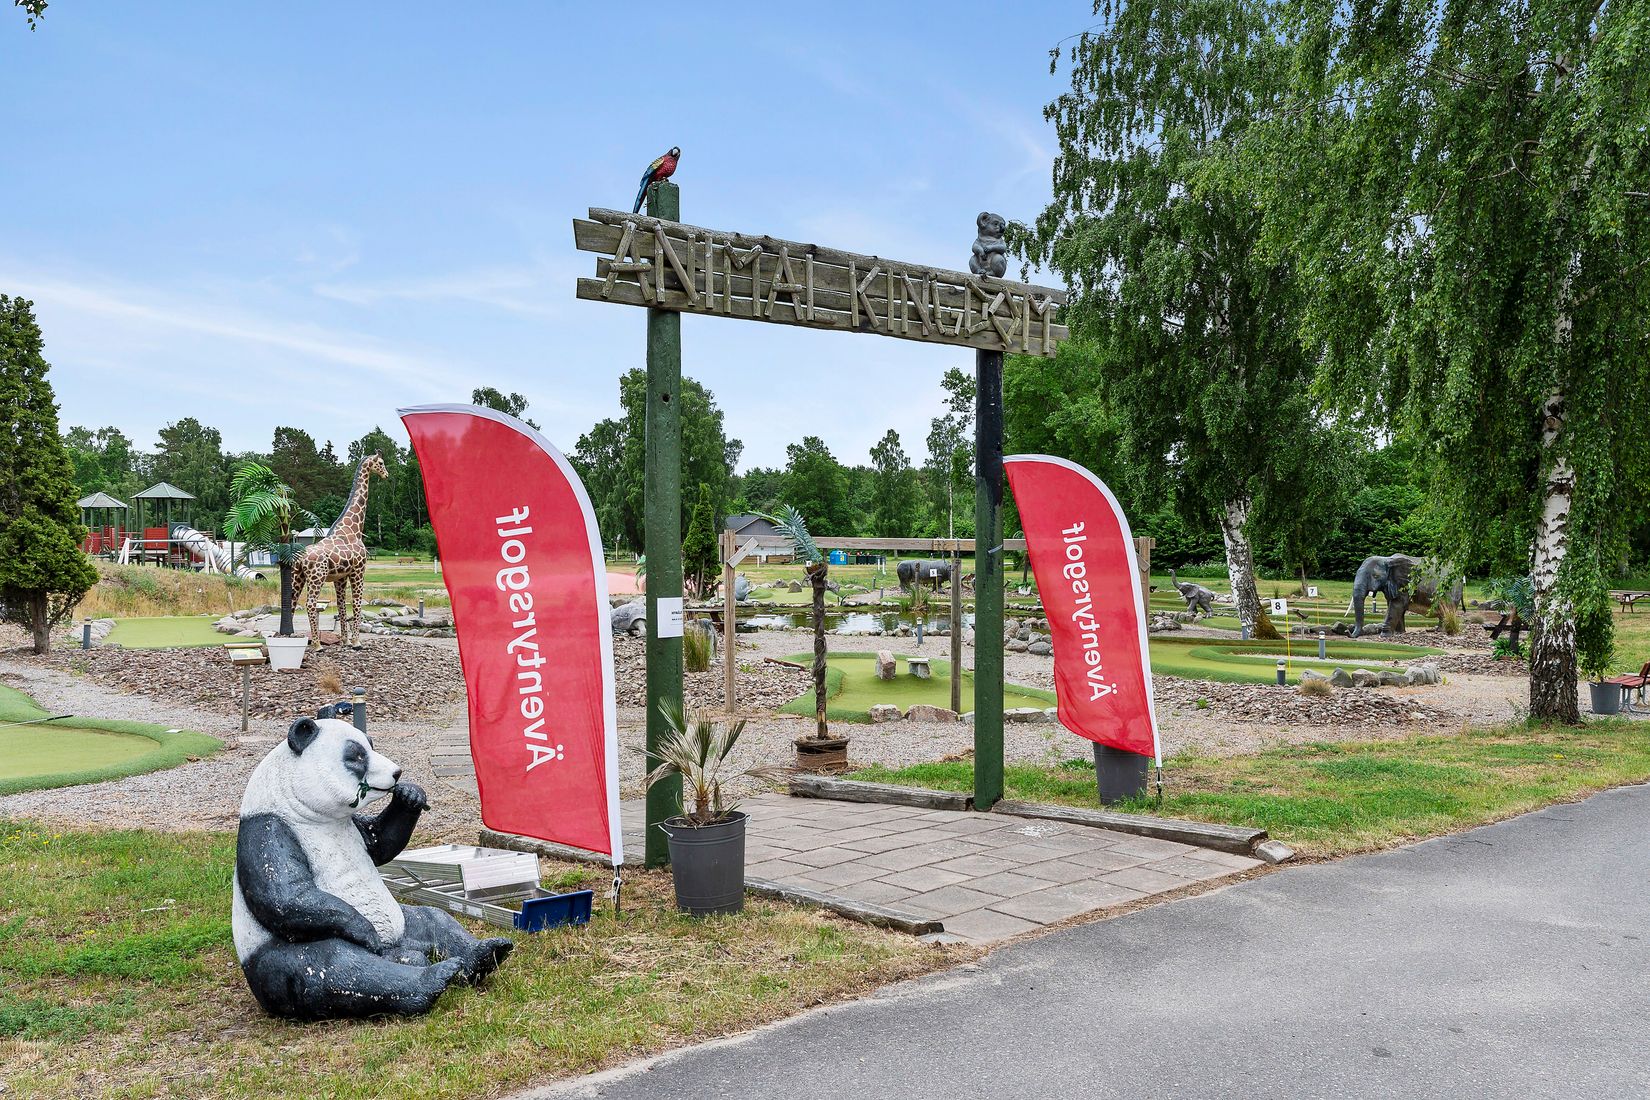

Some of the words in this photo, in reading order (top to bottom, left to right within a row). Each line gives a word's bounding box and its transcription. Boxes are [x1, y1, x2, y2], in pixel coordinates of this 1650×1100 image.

[601, 220, 837, 325] ANIMAL
[849, 260, 1052, 354] KINGDOM
[1275, 602, 1281, 610] 8
